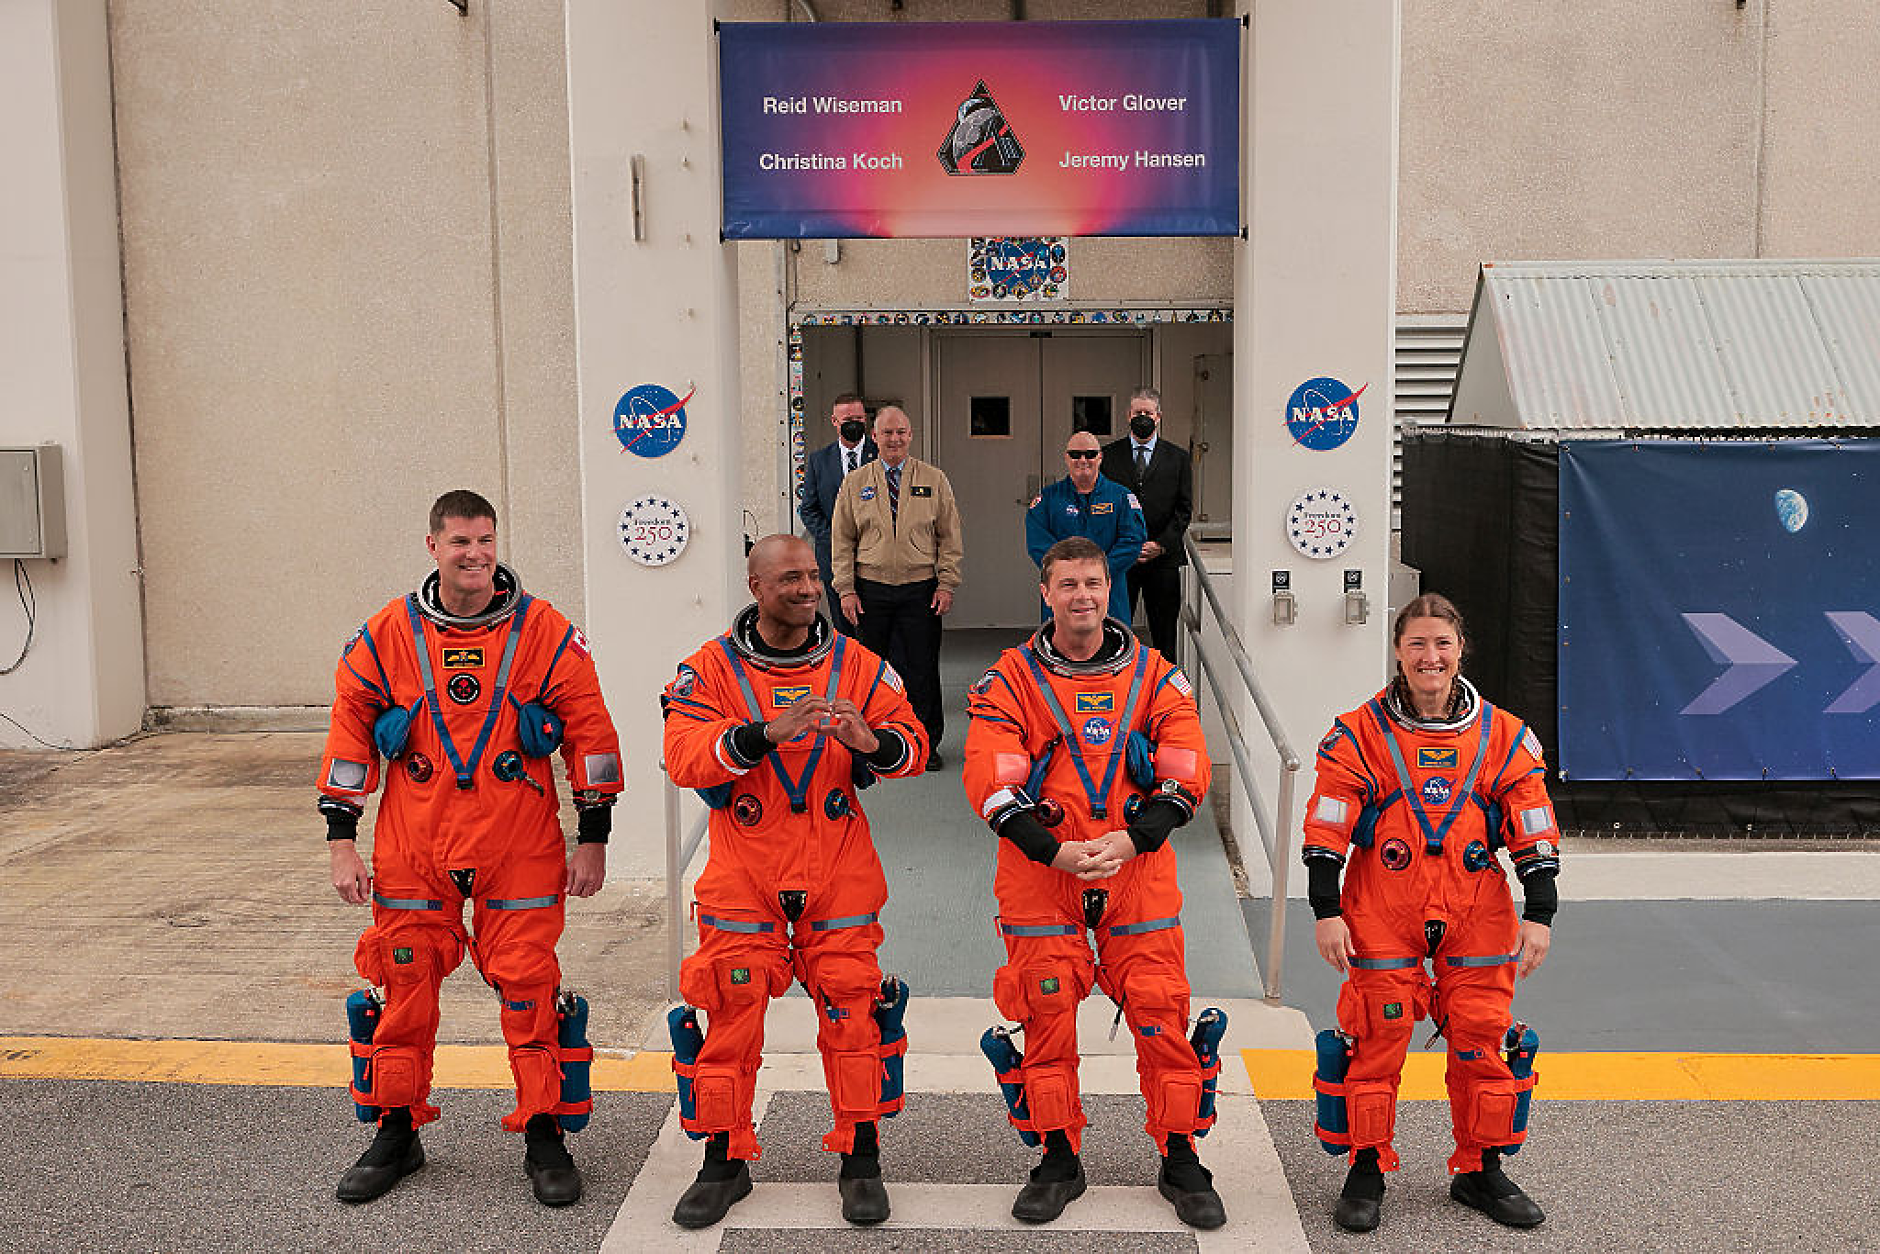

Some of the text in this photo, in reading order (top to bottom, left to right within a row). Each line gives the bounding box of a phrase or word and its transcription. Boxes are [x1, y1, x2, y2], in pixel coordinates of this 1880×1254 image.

[763, 96, 903, 114] Reid Wiseman
[1058, 94, 1187, 112] Victor Glover
[759, 153, 903, 170] Christina Koch
[1058, 151, 1206, 172] Jeremy Hansen
[991, 256, 1048, 271] NASA
[619, 414, 683, 429] NASA
[1292, 407, 1356, 422] NASA
[634, 526, 673, 546] 250
[1304, 519, 1341, 539] 250
